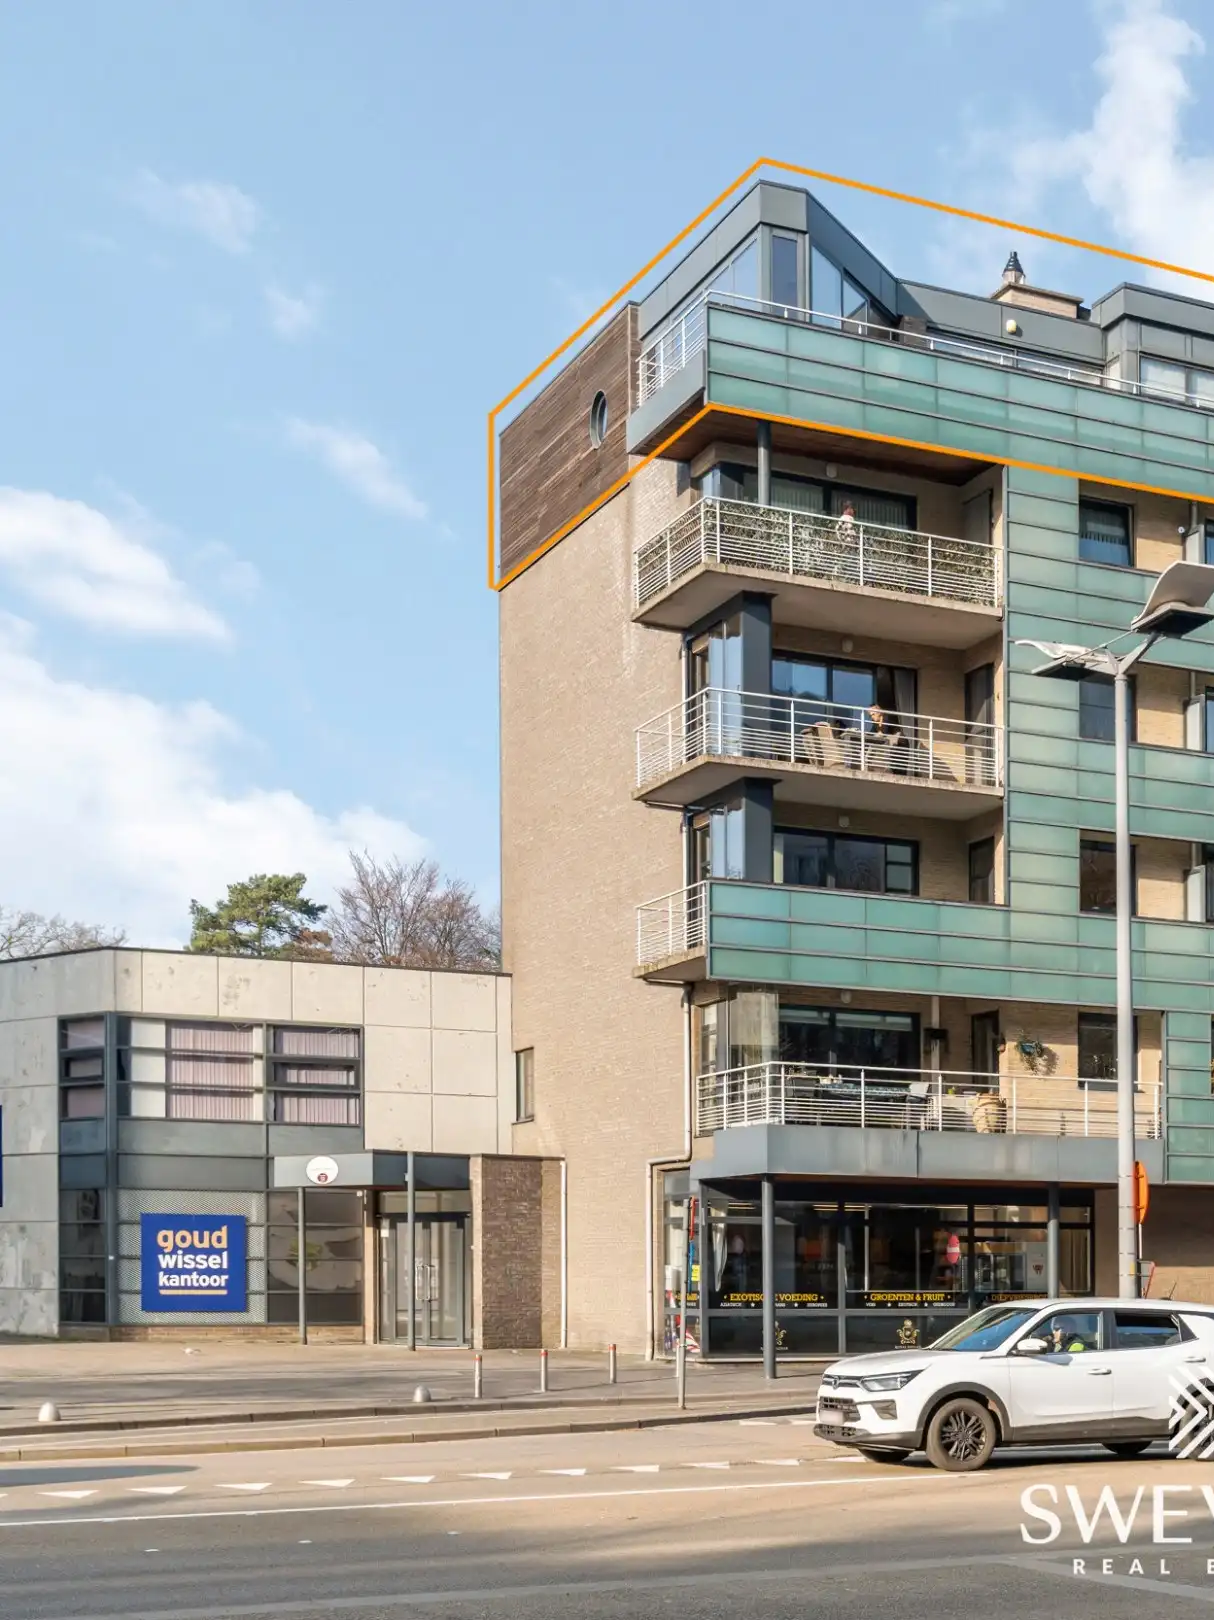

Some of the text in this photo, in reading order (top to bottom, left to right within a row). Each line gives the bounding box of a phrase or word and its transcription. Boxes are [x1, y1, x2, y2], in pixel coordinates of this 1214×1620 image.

[157, 1225, 228, 1253] goud
[157, 1249, 228, 1269] wissel
[158, 1271, 229, 1287] kantoor
[730, 1293, 818, 1301] EXOTISC VOEDING
[870, 1293, 945, 1301] GROENTEN & FRUIT
